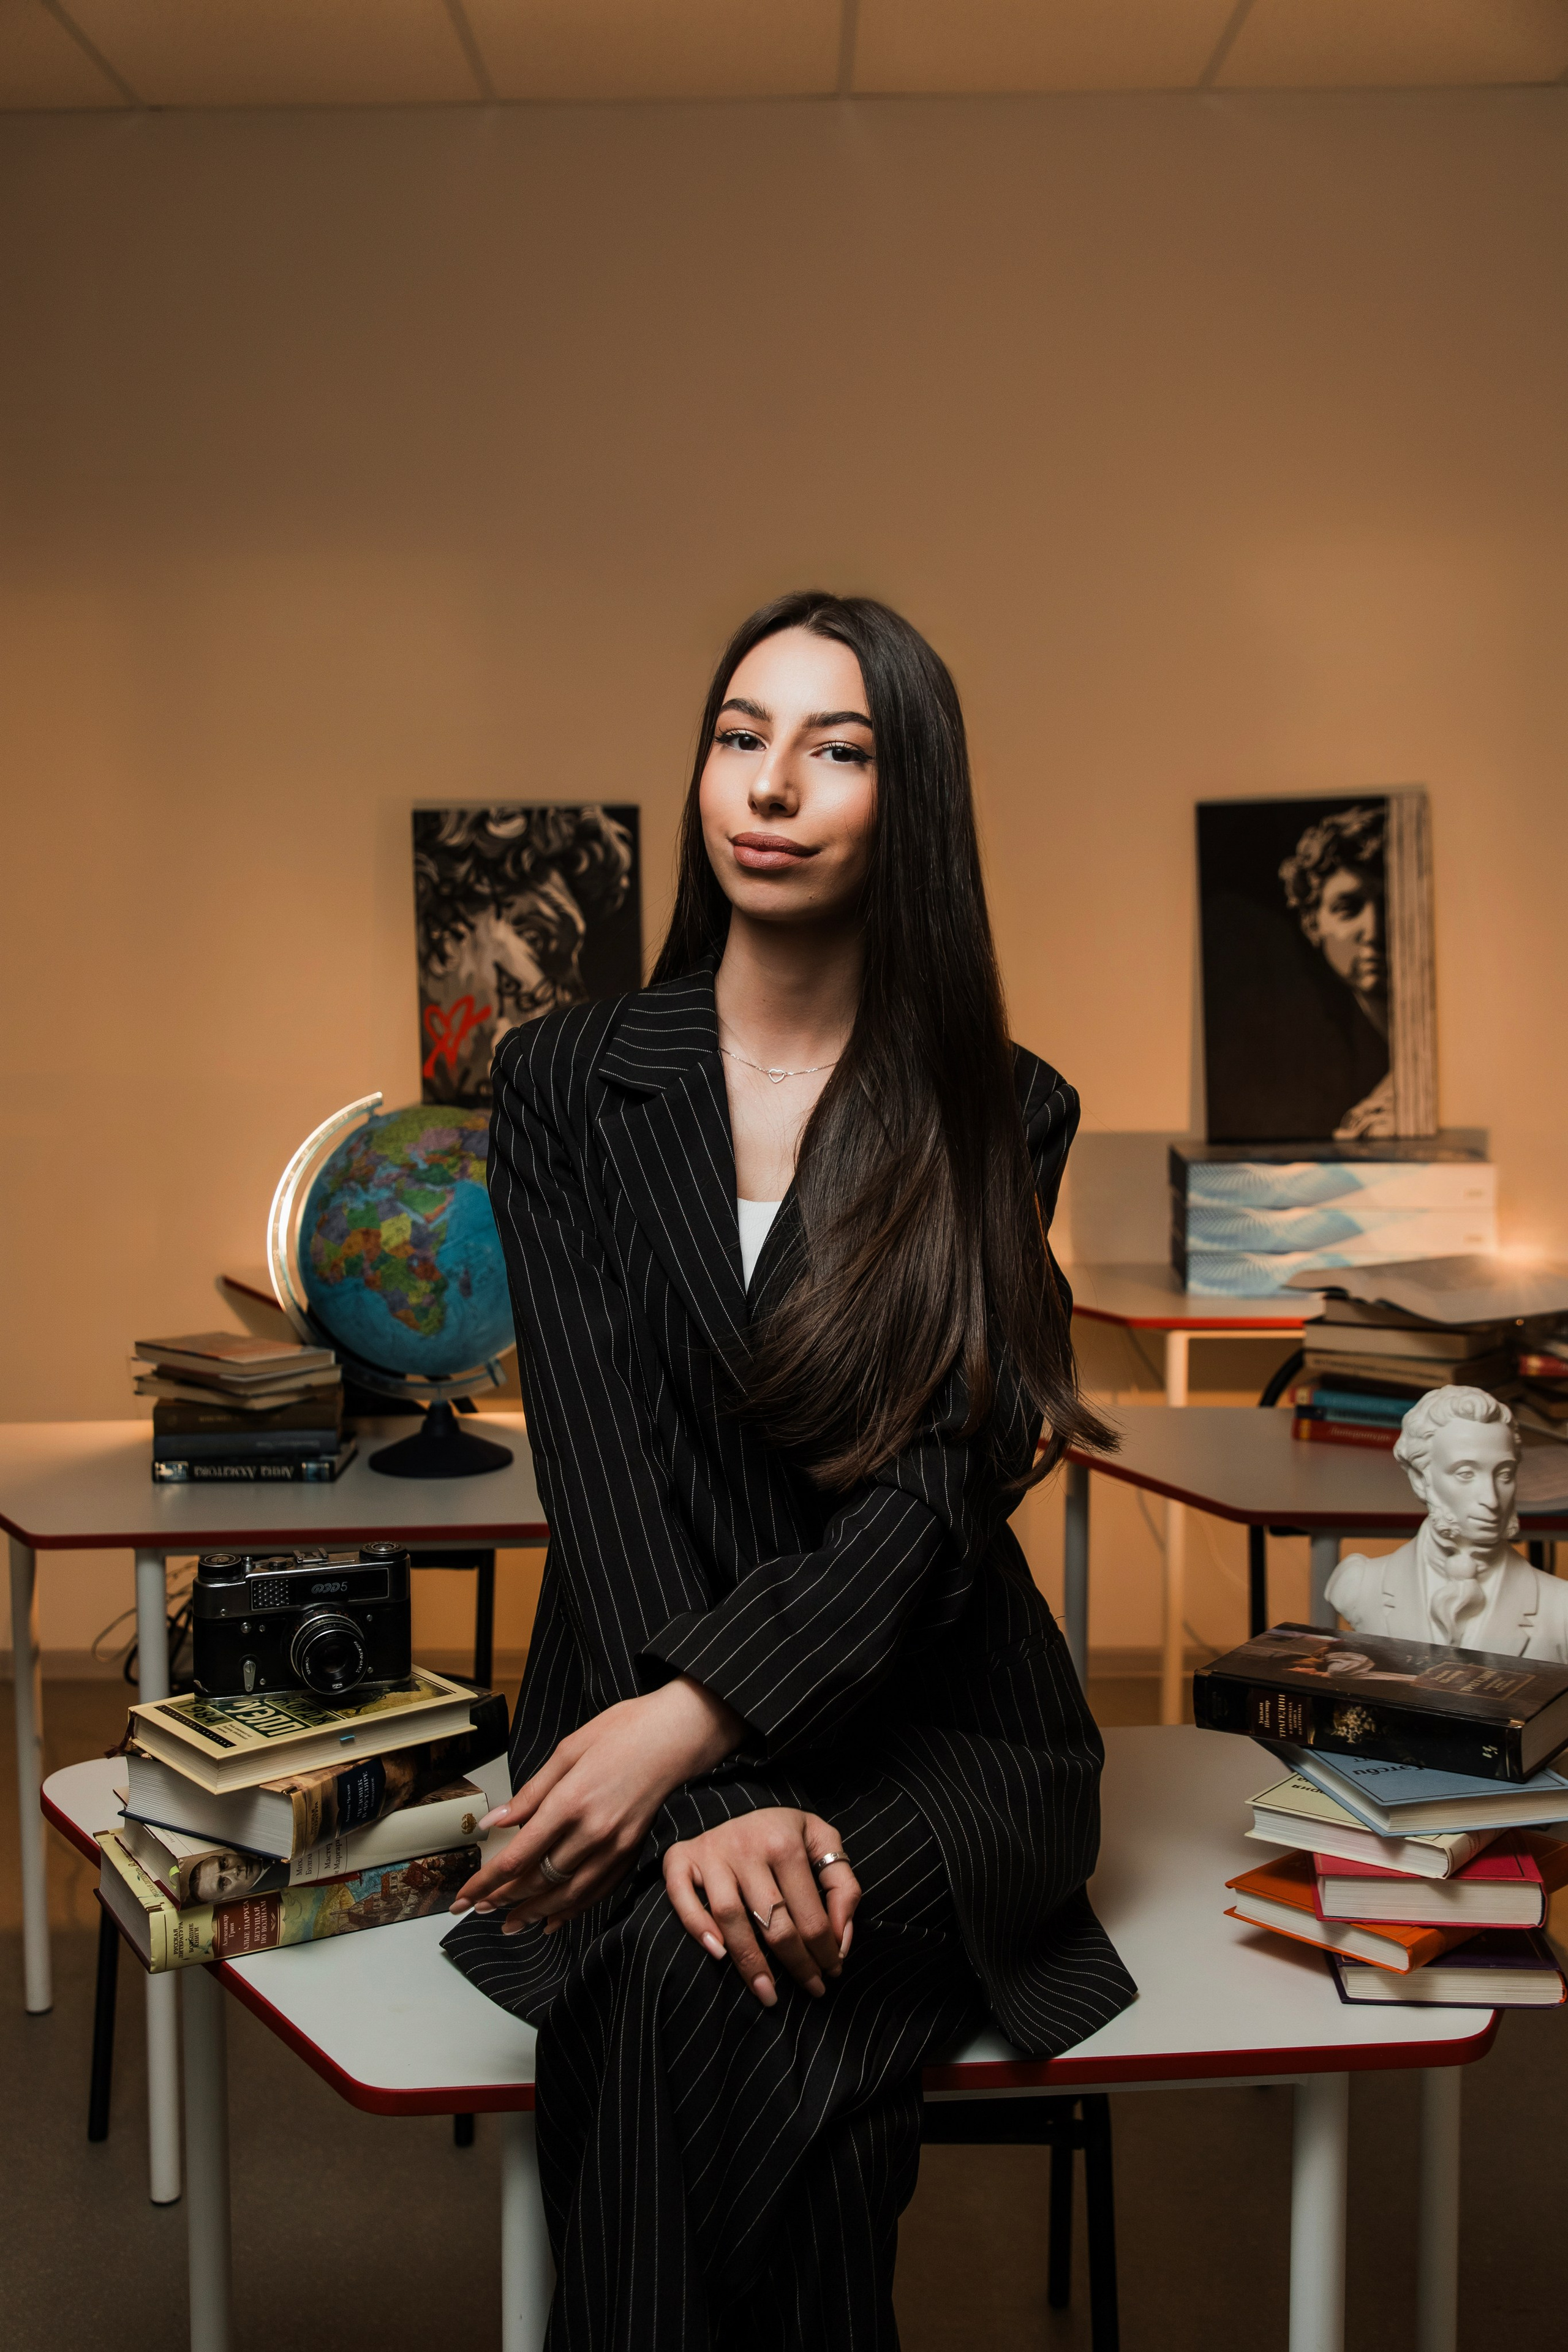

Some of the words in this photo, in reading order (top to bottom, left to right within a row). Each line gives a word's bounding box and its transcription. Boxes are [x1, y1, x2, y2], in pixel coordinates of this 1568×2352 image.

[176, 1701, 226, 1724] 1984
[224, 1701, 300, 1736] УЭЛЛ
[276, 1697, 337, 1725] ЖОРДЖ
[1278, 1694, 1286, 1738] ТРАГЕДИИ
[261, 1934, 266, 1944] ПО
